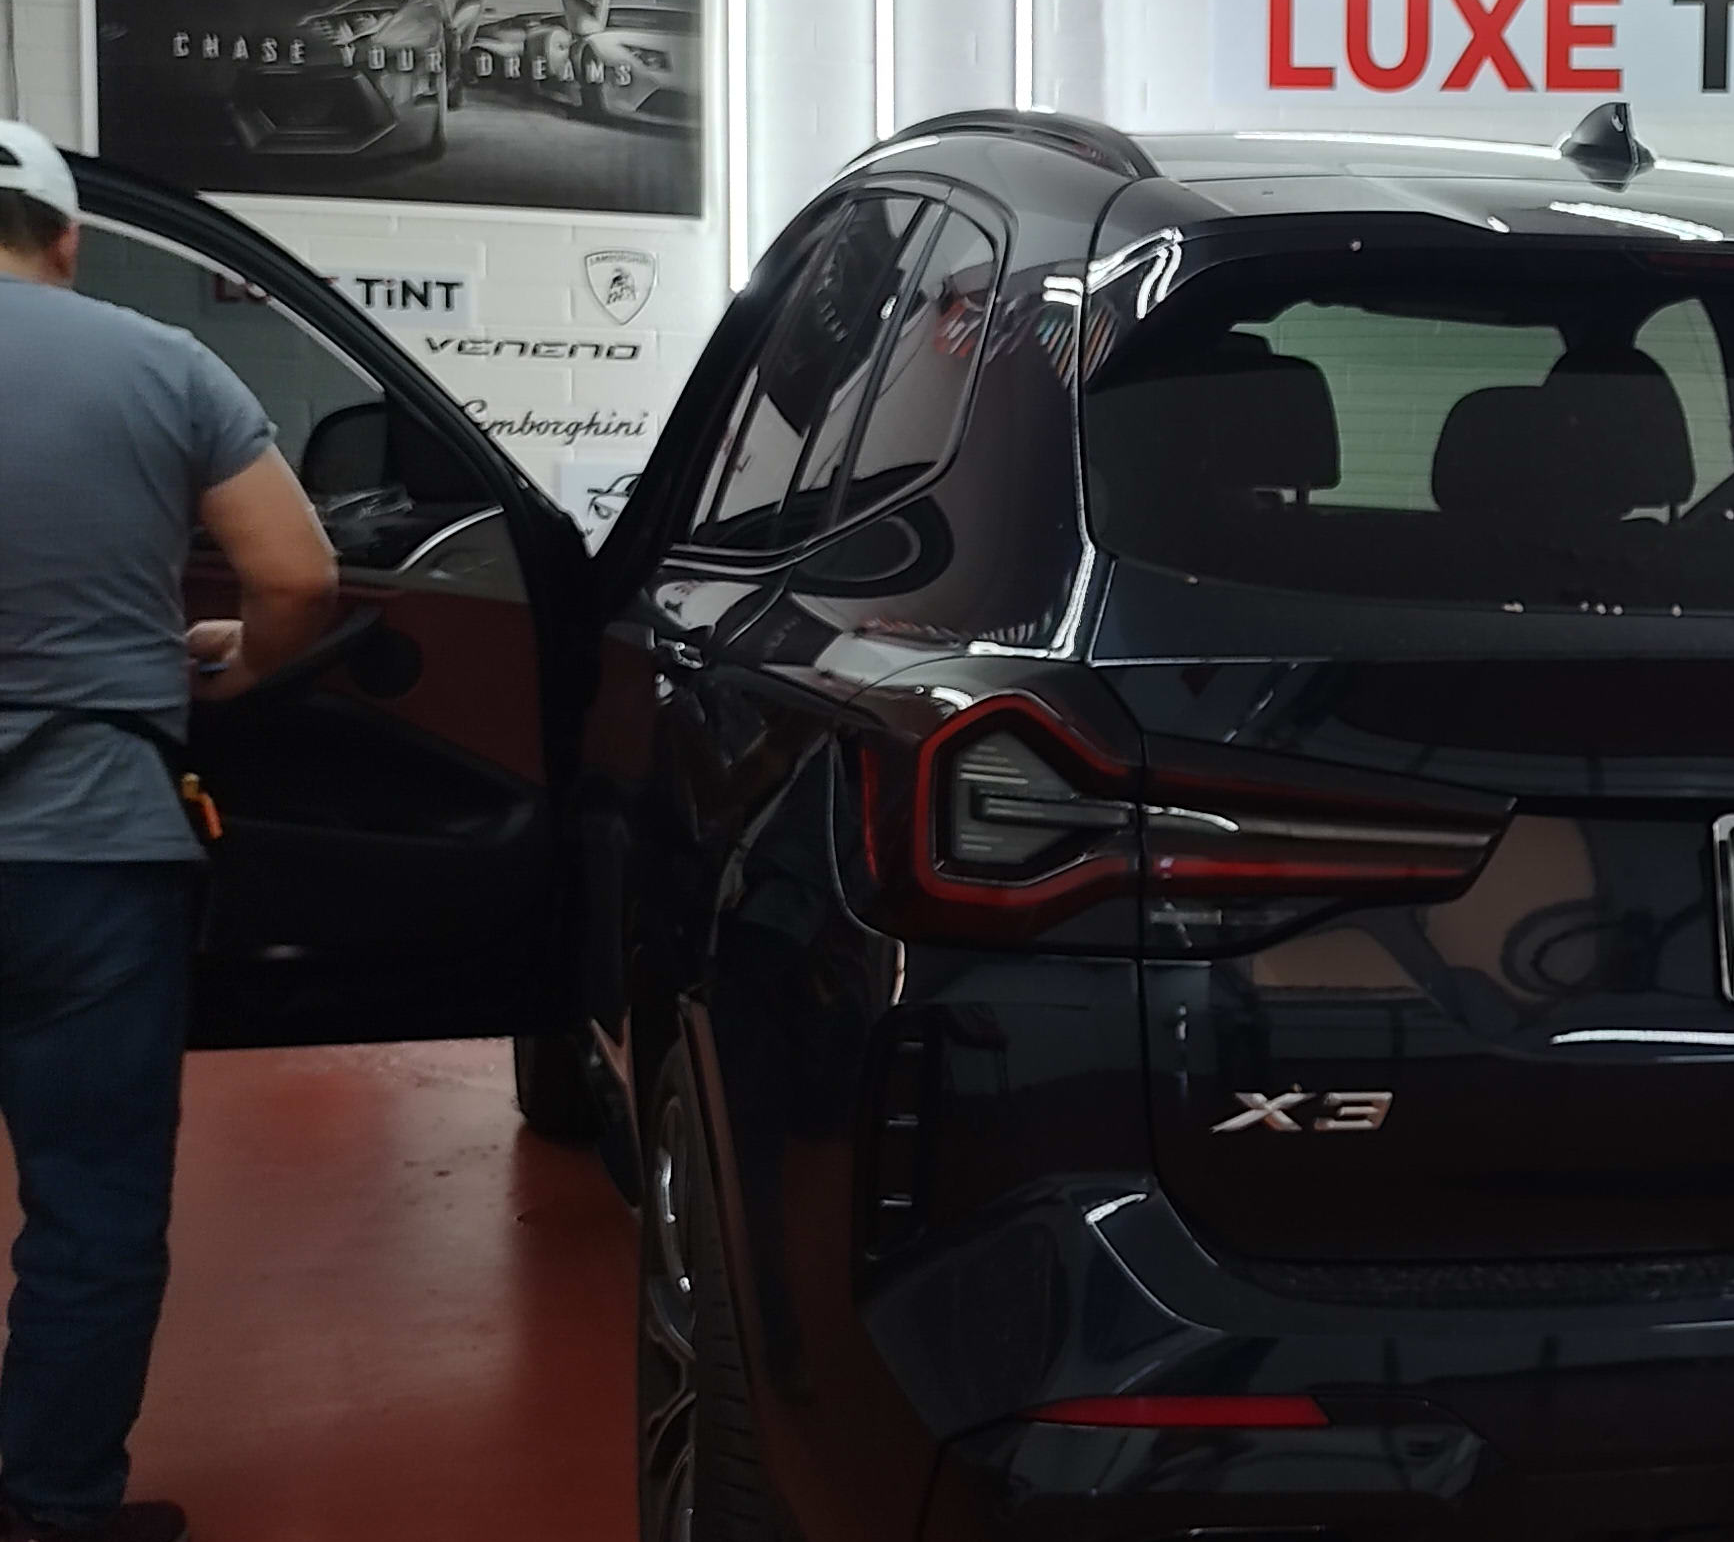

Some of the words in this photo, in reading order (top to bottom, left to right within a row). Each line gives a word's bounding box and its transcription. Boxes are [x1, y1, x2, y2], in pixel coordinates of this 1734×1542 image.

[172, 31, 305, 65] CHASE
[339, 42, 444, 74] YOUR
[475, 51, 632, 87] DREAMS
[355, 276, 463, 309] TiNT
[1210, 1091, 1394, 1132] X3
